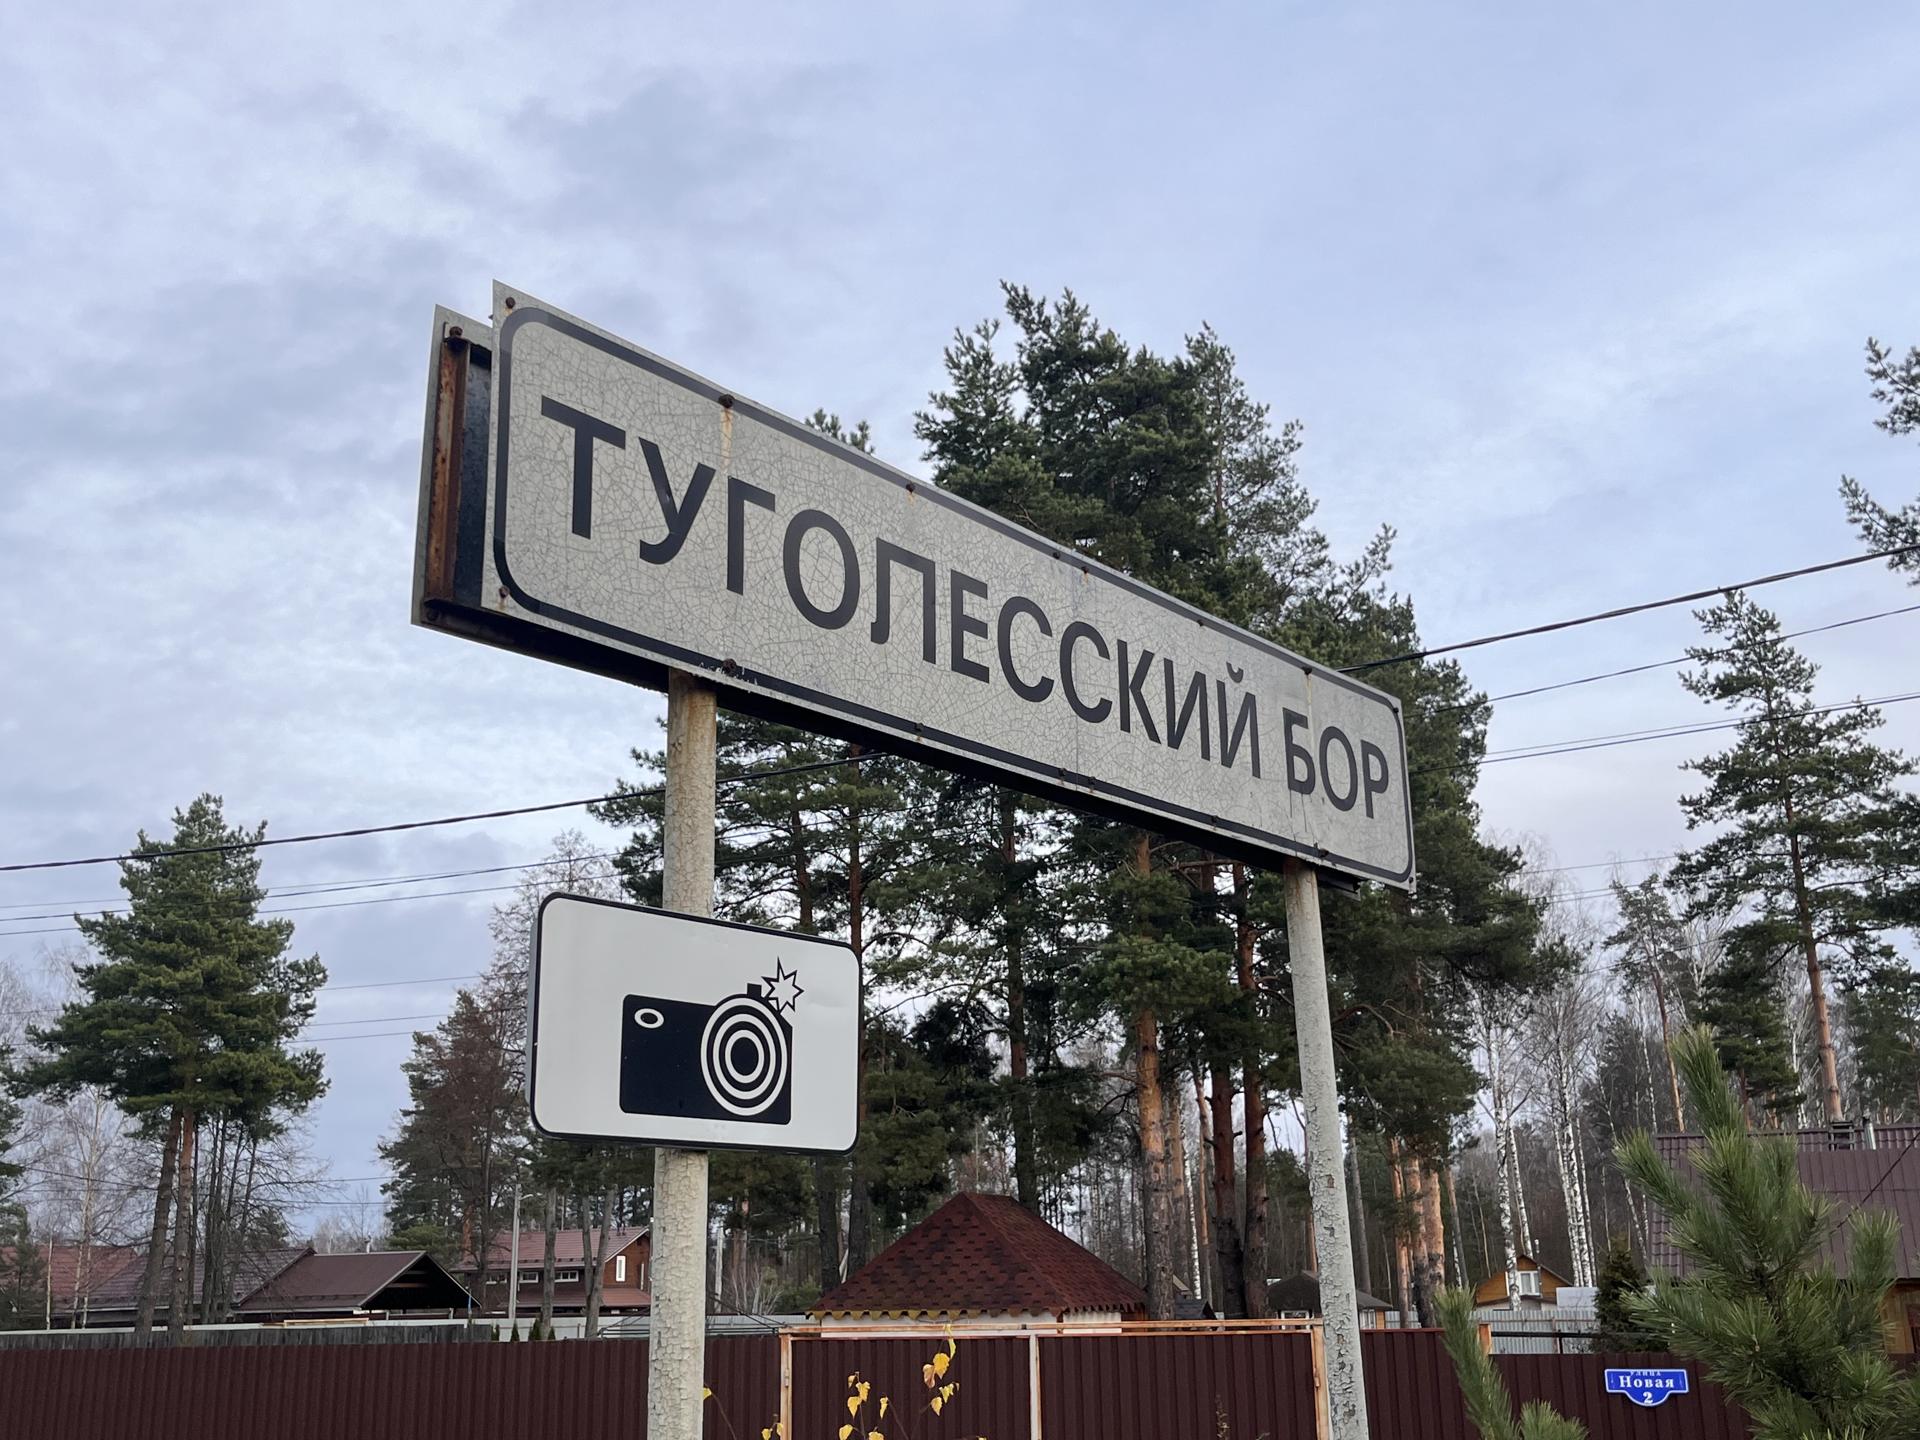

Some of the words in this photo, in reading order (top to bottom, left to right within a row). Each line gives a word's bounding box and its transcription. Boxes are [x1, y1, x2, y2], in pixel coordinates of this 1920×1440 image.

[541, 396, 1260, 779] ТУГОЛЕССКИЙ
[1282, 708, 1389, 818] БОР
[1619, 1375, 1674, 1388] Новая
[1642, 1391, 1654, 1404] 2
